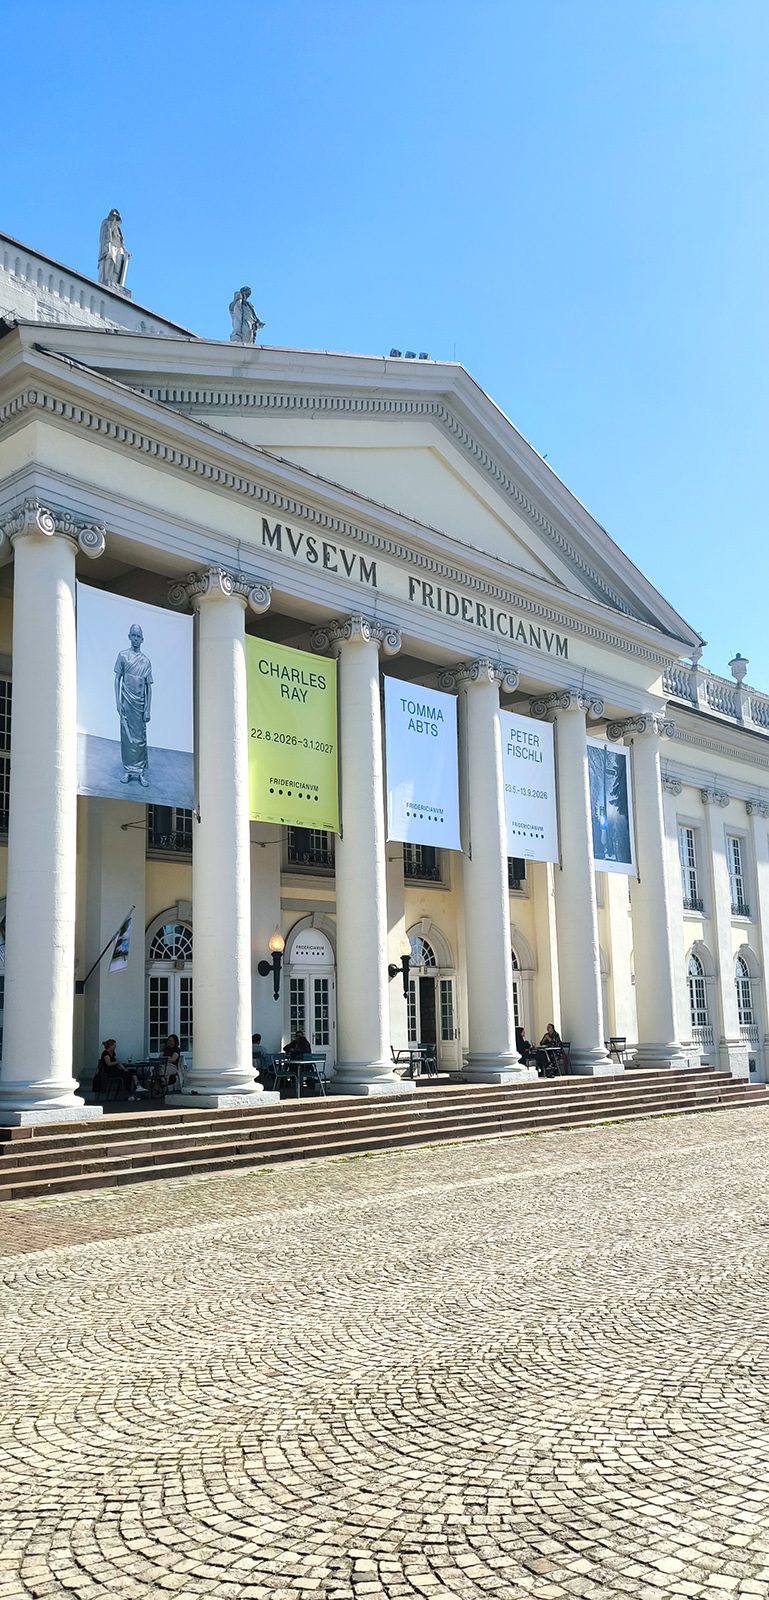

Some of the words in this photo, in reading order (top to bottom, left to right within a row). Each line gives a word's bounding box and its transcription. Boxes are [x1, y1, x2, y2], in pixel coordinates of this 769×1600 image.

[261, 517, 378, 587] MVSEVM
[408, 575, 569, 659] FRIDERICIANVM
[258, 659, 326, 690] CHARLES
[280, 684, 308, 703] RAY
[400, 698, 444, 722] TOMMA
[408, 718, 439, 737] ABTS
[510, 728, 540, 748] PETER
[507, 743, 543, 763] FISCHLI
[269, 777, 319, 792] FRIDERICIANVM
[405, 802, 444, 815] FRIDERICIANVM
